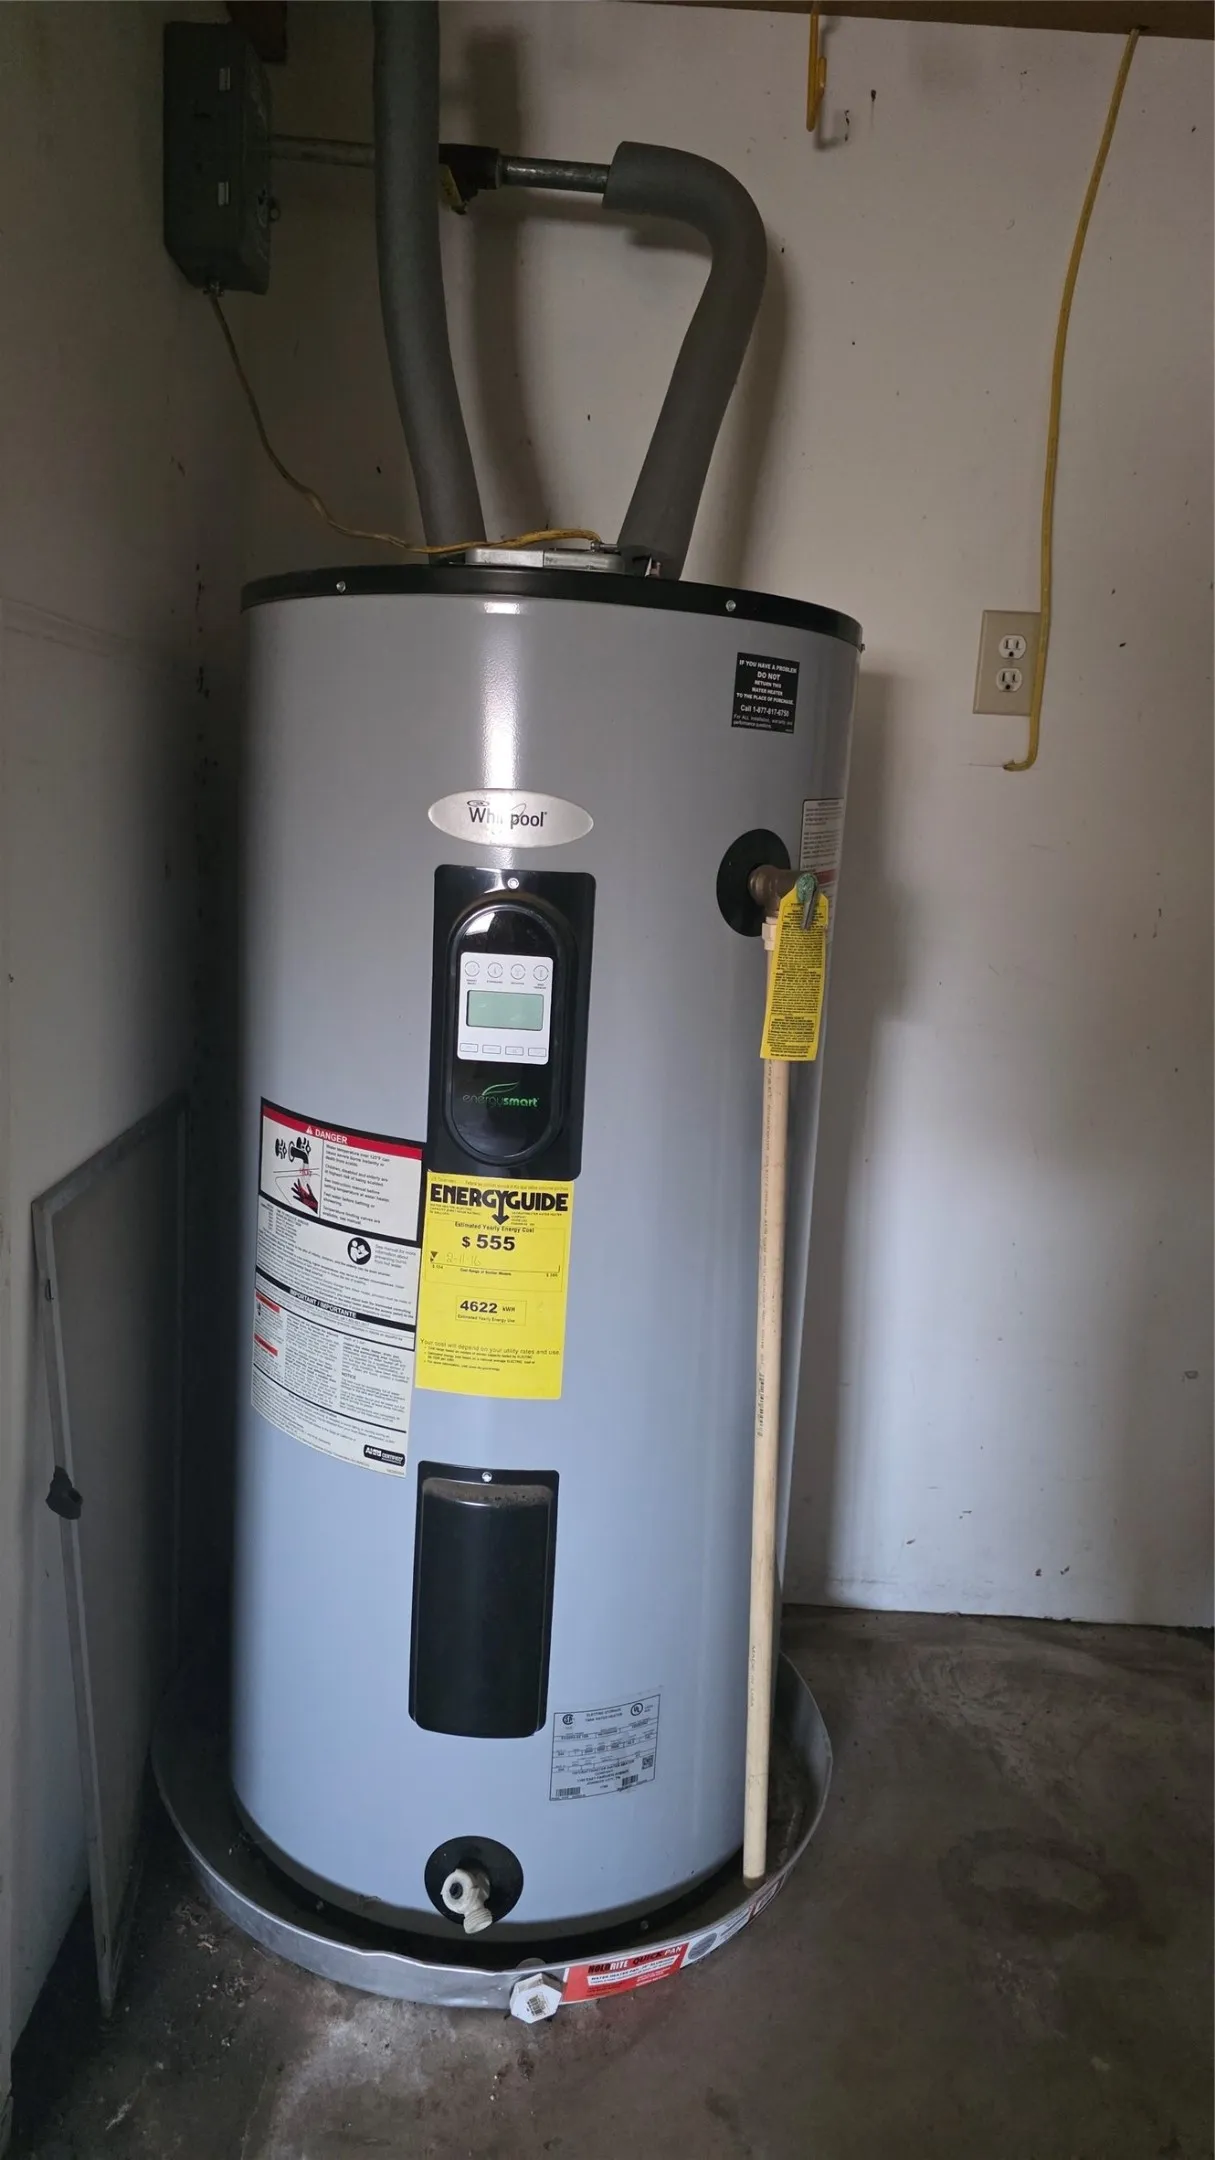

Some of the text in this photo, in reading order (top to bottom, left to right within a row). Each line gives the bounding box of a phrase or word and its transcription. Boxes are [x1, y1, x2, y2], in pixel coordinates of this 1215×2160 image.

[757, 671, 781, 681] DO NOT
[740, 704, 752, 712] Call
[314, 1128, 348, 1145] DANGER
[430, 1183, 569, 1212] ENERGYGUIDE
[454, 1220, 482, 1230] Estimated
[482, 1223, 500, 1232] Yearly
[501, 1225, 521, 1234] Energy
[461, 1234, 516, 1251] $ 555
[320, 1301, 357, 1319] IMPORTANTE
[460, 1300, 498, 1314] 4622
[420, 1338, 434, 1346] Your
[458, 1343, 480, 1351] depend
[503, 1347, 519, 1355] utility
[632, 1952, 662, 1965] QUICK
[664, 1946, 682, 1956] PAN
